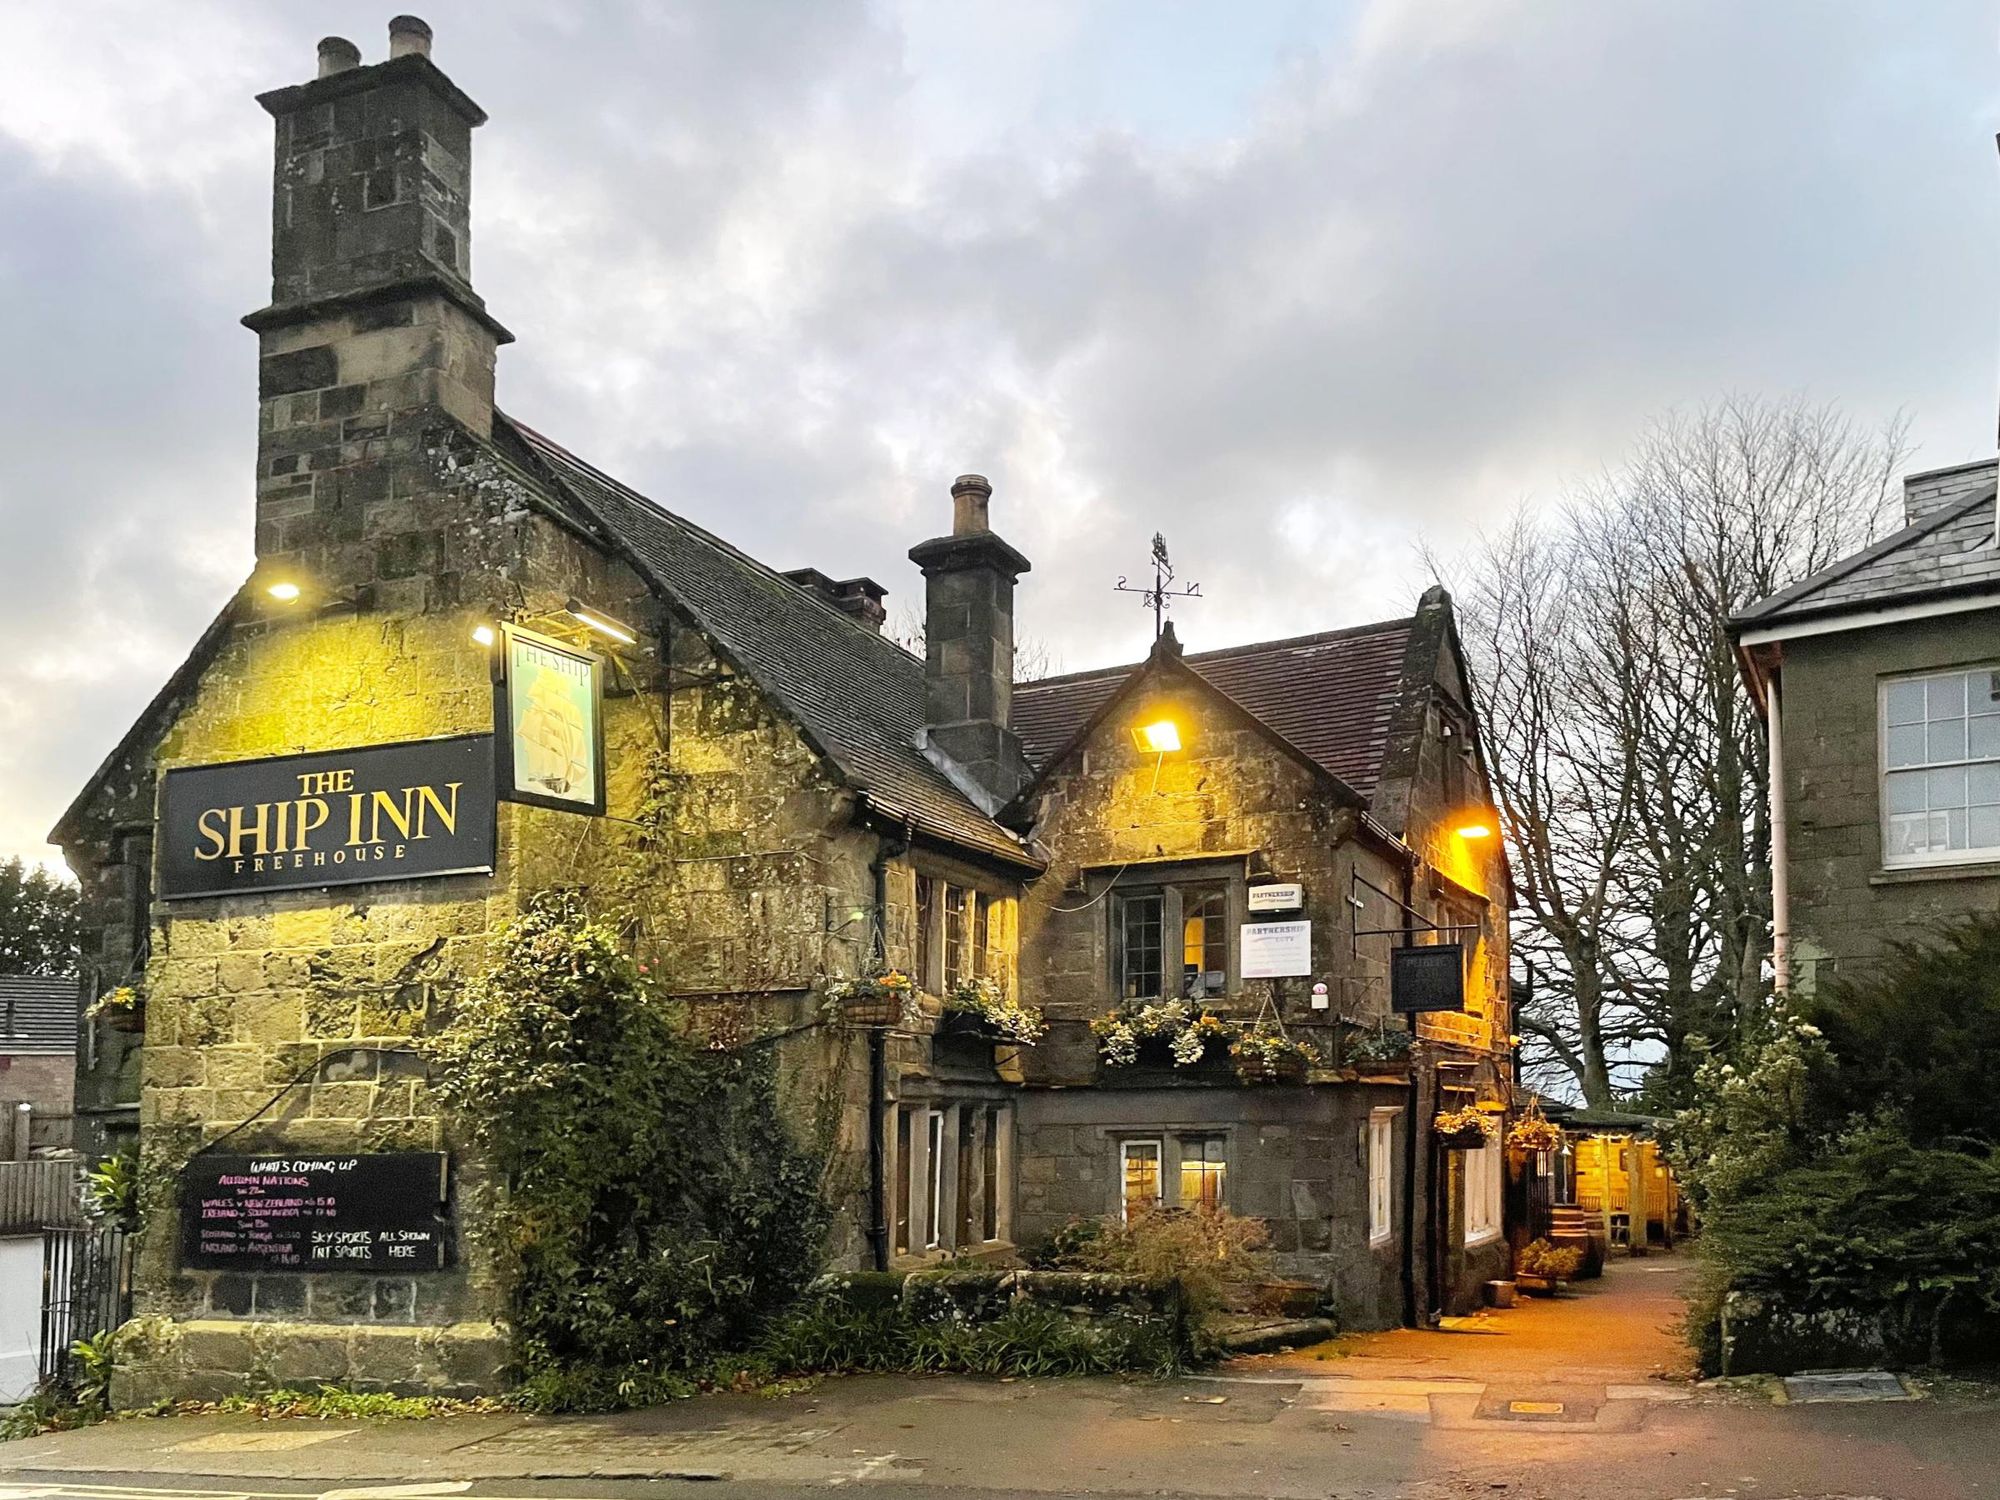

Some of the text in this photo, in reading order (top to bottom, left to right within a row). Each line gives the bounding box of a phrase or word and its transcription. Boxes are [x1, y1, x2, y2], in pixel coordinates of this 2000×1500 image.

[551, 655, 589, 687] SHIP
[297, 769, 354, 796] THE
[195, 782, 463, 861] SHIP INN
[234, 844, 406, 874] FREEHOUSE
[1246, 925, 1306, 936] PARTNERSHIP
[292, 1160, 335, 1173] COMING
[338, 1159, 357, 1171] UP
[219, 1175, 310, 1187] AUTUMN NATIONS
[201, 1198, 234, 1208] WALES
[244, 1199, 263, 1208] NEW
[264, 1198, 303, 1207] ZEALAND
[201, 1209, 238, 1219] IRELAND
[247, 1209, 271, 1217] SOUTH
[200, 1229, 237, 1239] SCOTLAND
[311, 1231, 372, 1244] SKY SPORTS
[378, 1229, 430, 1242] ALL SHOWN
[200, 1241, 238, 1252] ENGLAND
[247, 1242, 293, 1254] ARGENTINA
[334, 1245, 372, 1259] SPORTS
[388, 1245, 417, 1258] HERE
